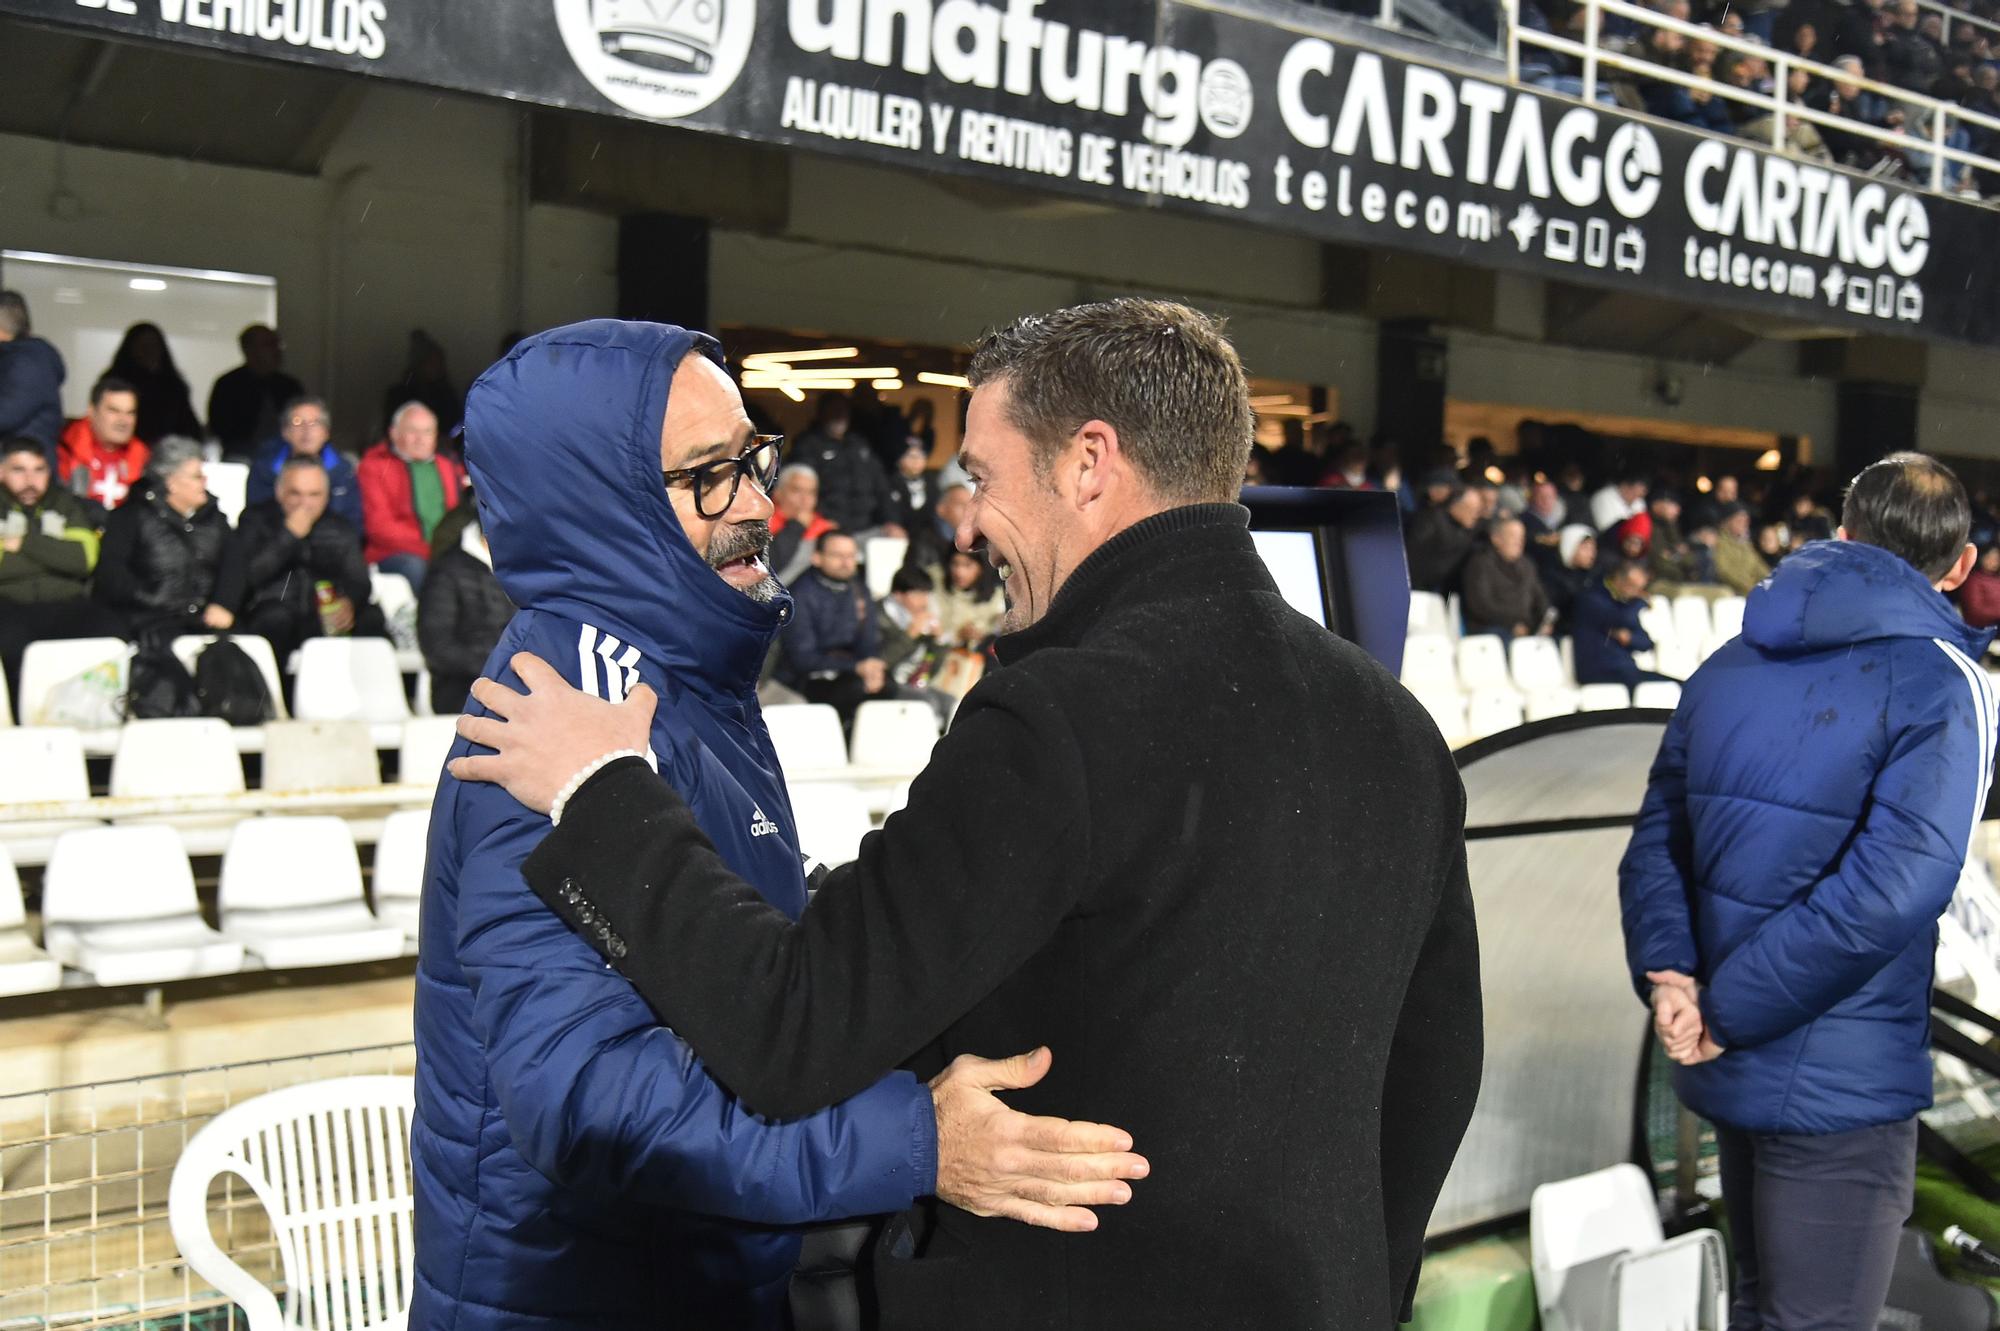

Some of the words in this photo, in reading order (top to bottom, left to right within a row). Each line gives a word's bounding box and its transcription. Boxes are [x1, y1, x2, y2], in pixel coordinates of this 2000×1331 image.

[780, 76, 922, 150] ALQUILER
[929, 102, 954, 154] Y
[959, 108, 1073, 177] RENTING
[1078, 132, 1116, 185] DE
[1274, 154, 1492, 243] telecom
[1684, 235, 1816, 300] telecom
[751, 821, 779, 837] ads
